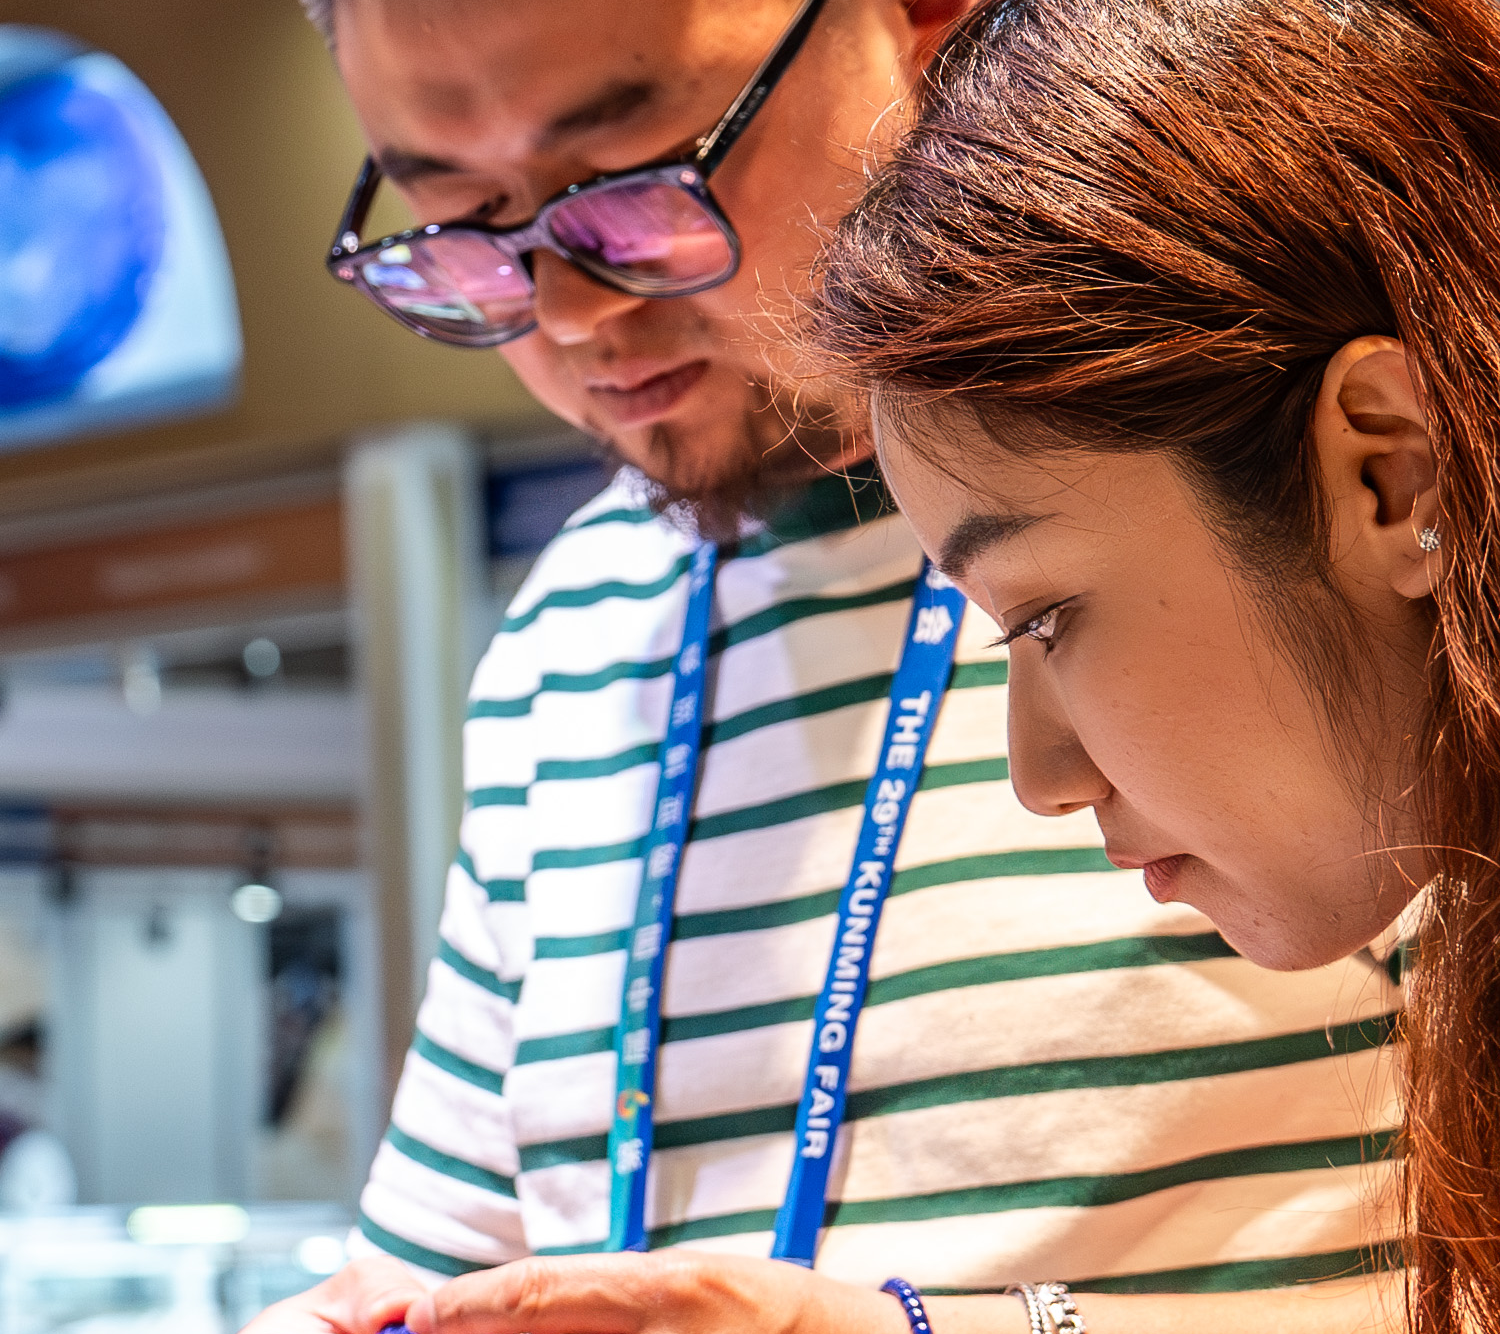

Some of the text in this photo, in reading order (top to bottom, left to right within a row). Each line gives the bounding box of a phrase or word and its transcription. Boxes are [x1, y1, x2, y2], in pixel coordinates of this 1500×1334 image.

[800, 690, 931, 1162] THE 29TH KUNMING FAIR
